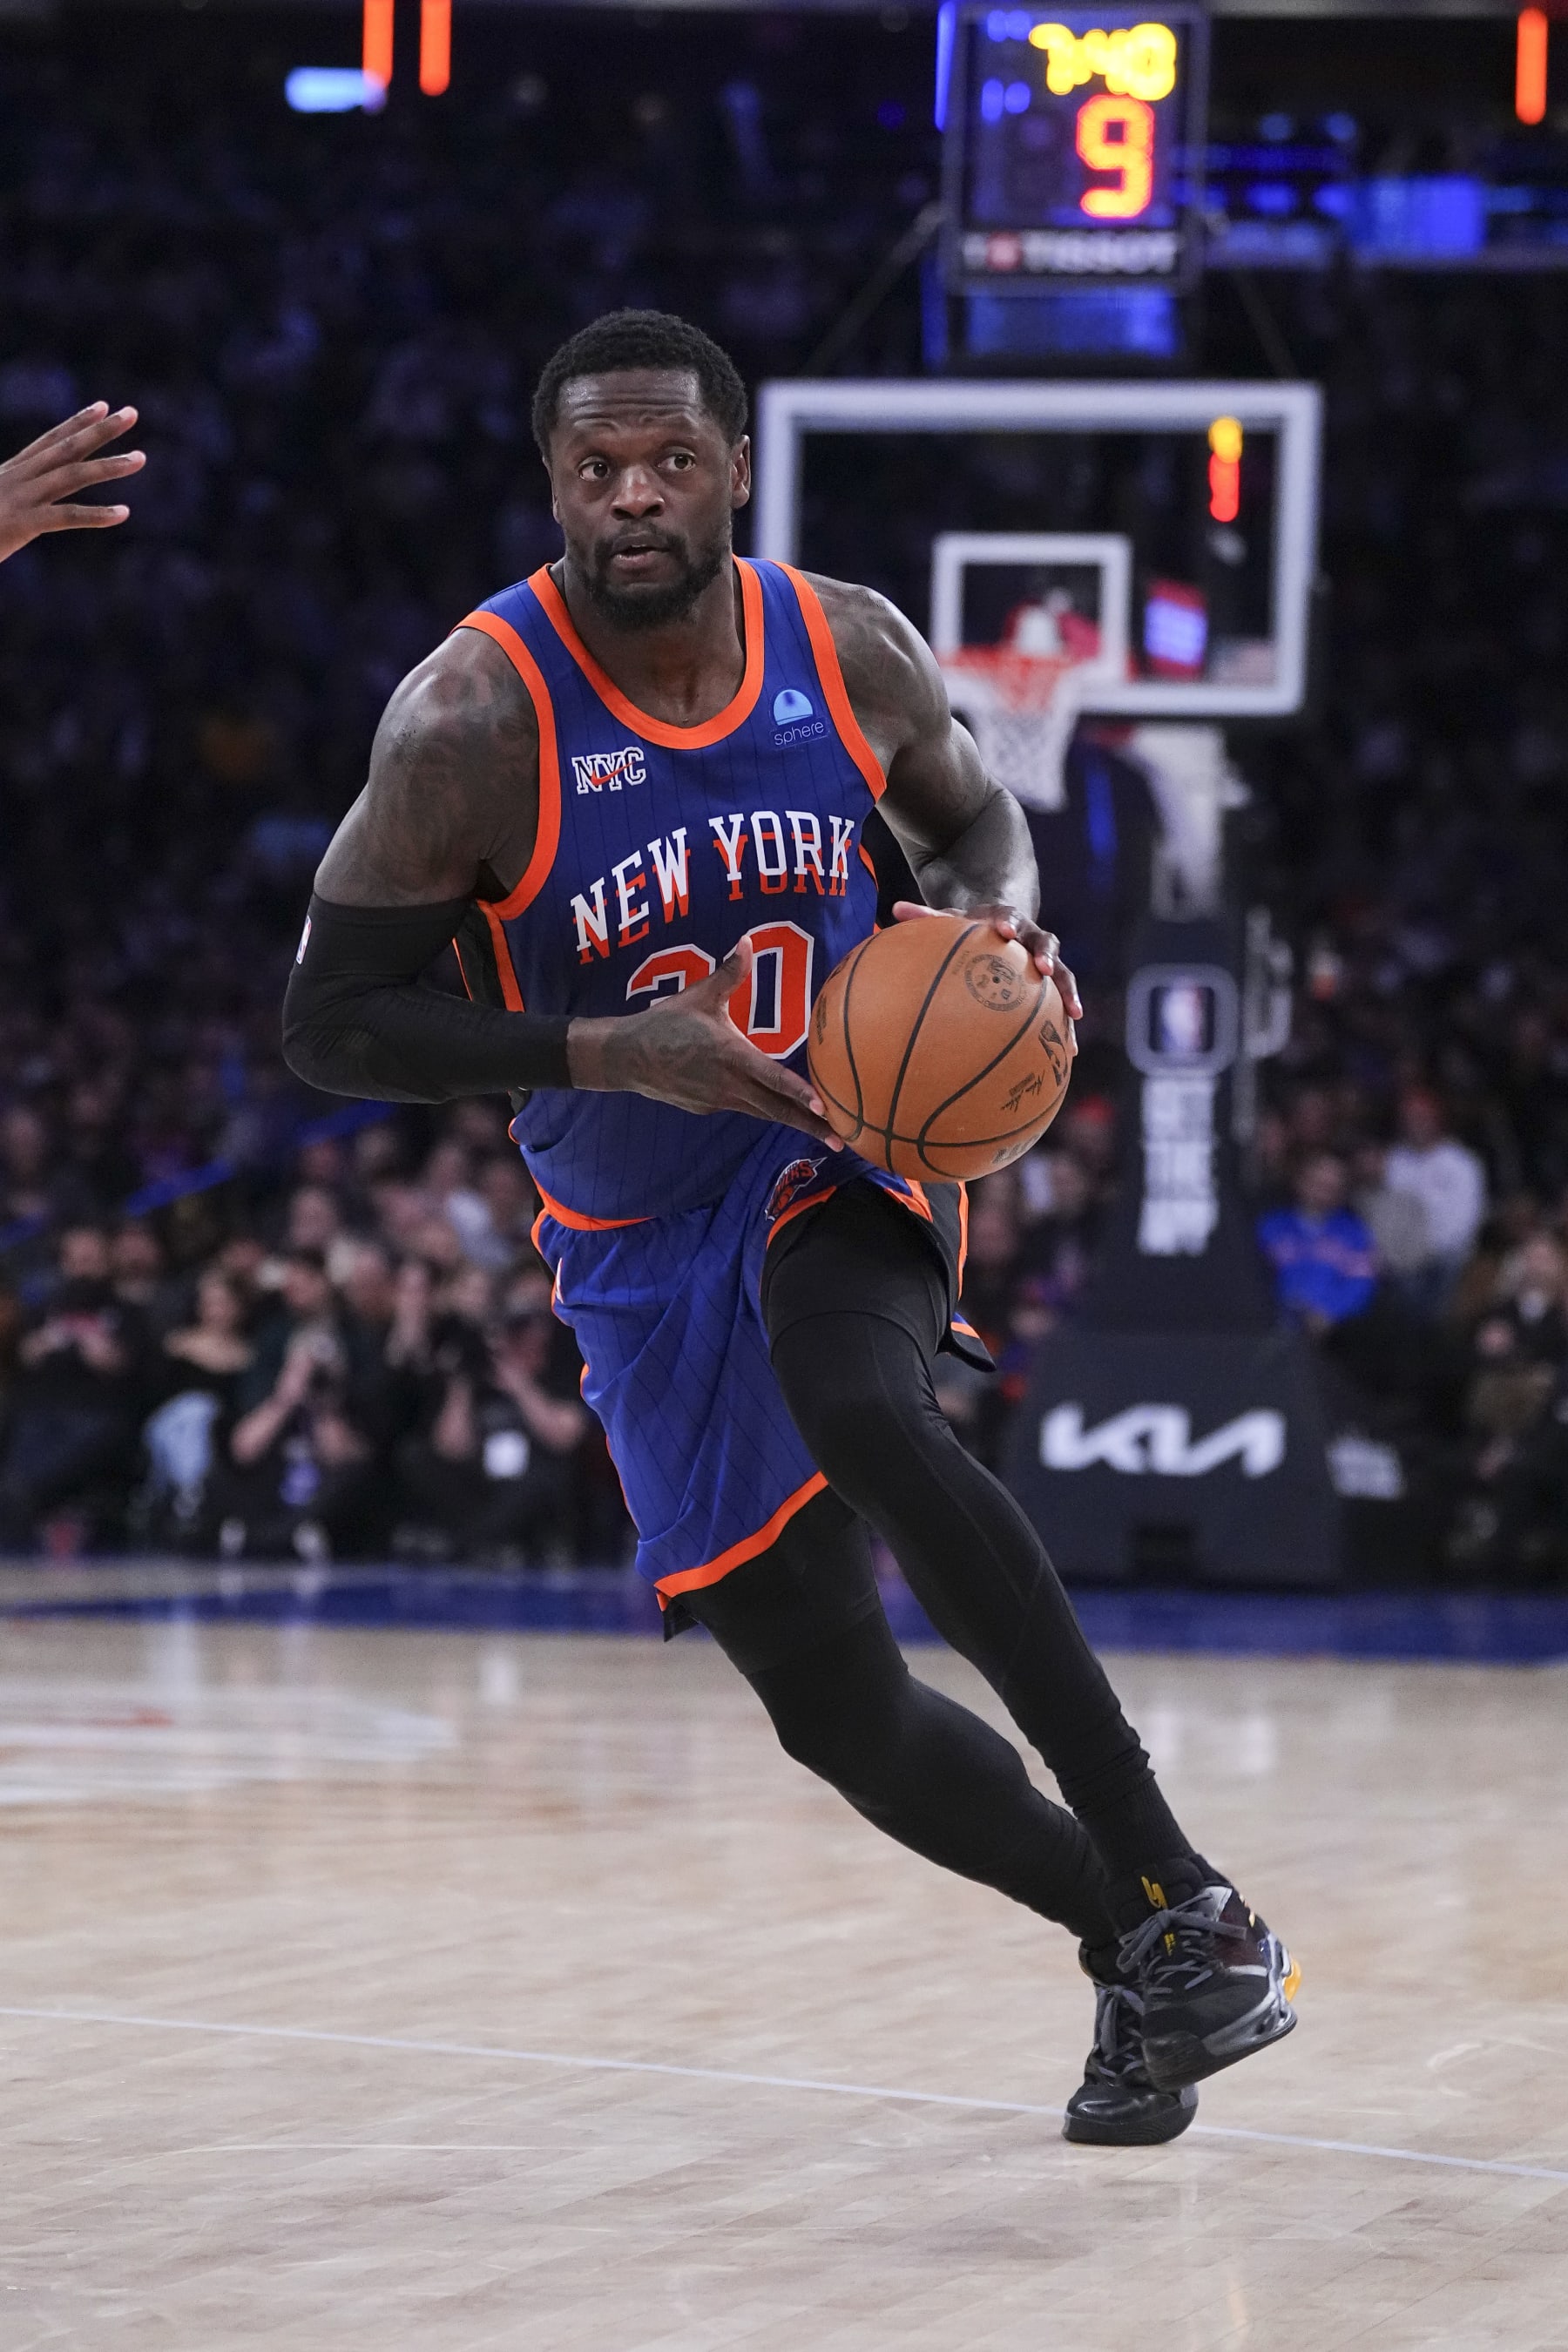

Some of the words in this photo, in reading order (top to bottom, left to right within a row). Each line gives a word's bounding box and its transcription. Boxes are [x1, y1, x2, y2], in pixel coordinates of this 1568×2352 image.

[1076, 94, 1154, 219] 9
[571, 746, 646, 795] NYC
[774, 721, 824, 746] sphere
[571, 827, 691, 964] NEW
[708, 810, 855, 901] YORK
